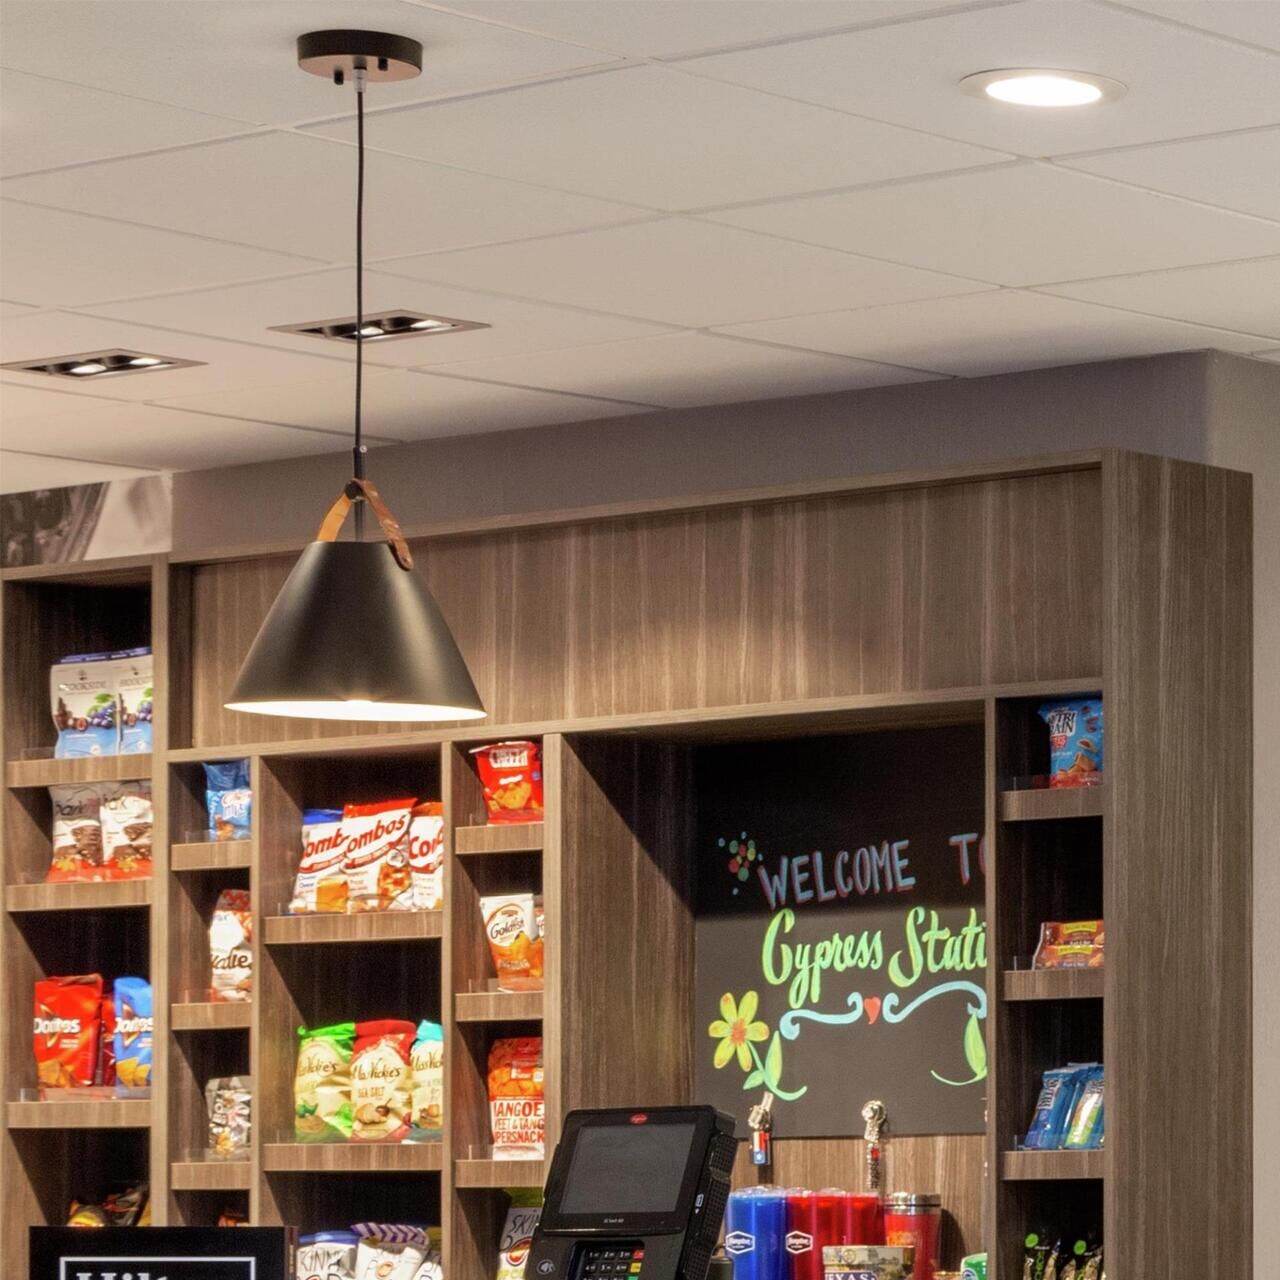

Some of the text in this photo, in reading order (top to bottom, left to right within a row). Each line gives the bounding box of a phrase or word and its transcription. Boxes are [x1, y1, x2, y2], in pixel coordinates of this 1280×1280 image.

[757, 840, 916, 909] WELCOME
[762, 908, 883, 1009] Cypress
[33, 1018, 81, 1034] Doritos
[494, 1102, 543, 1117] ANGOE
